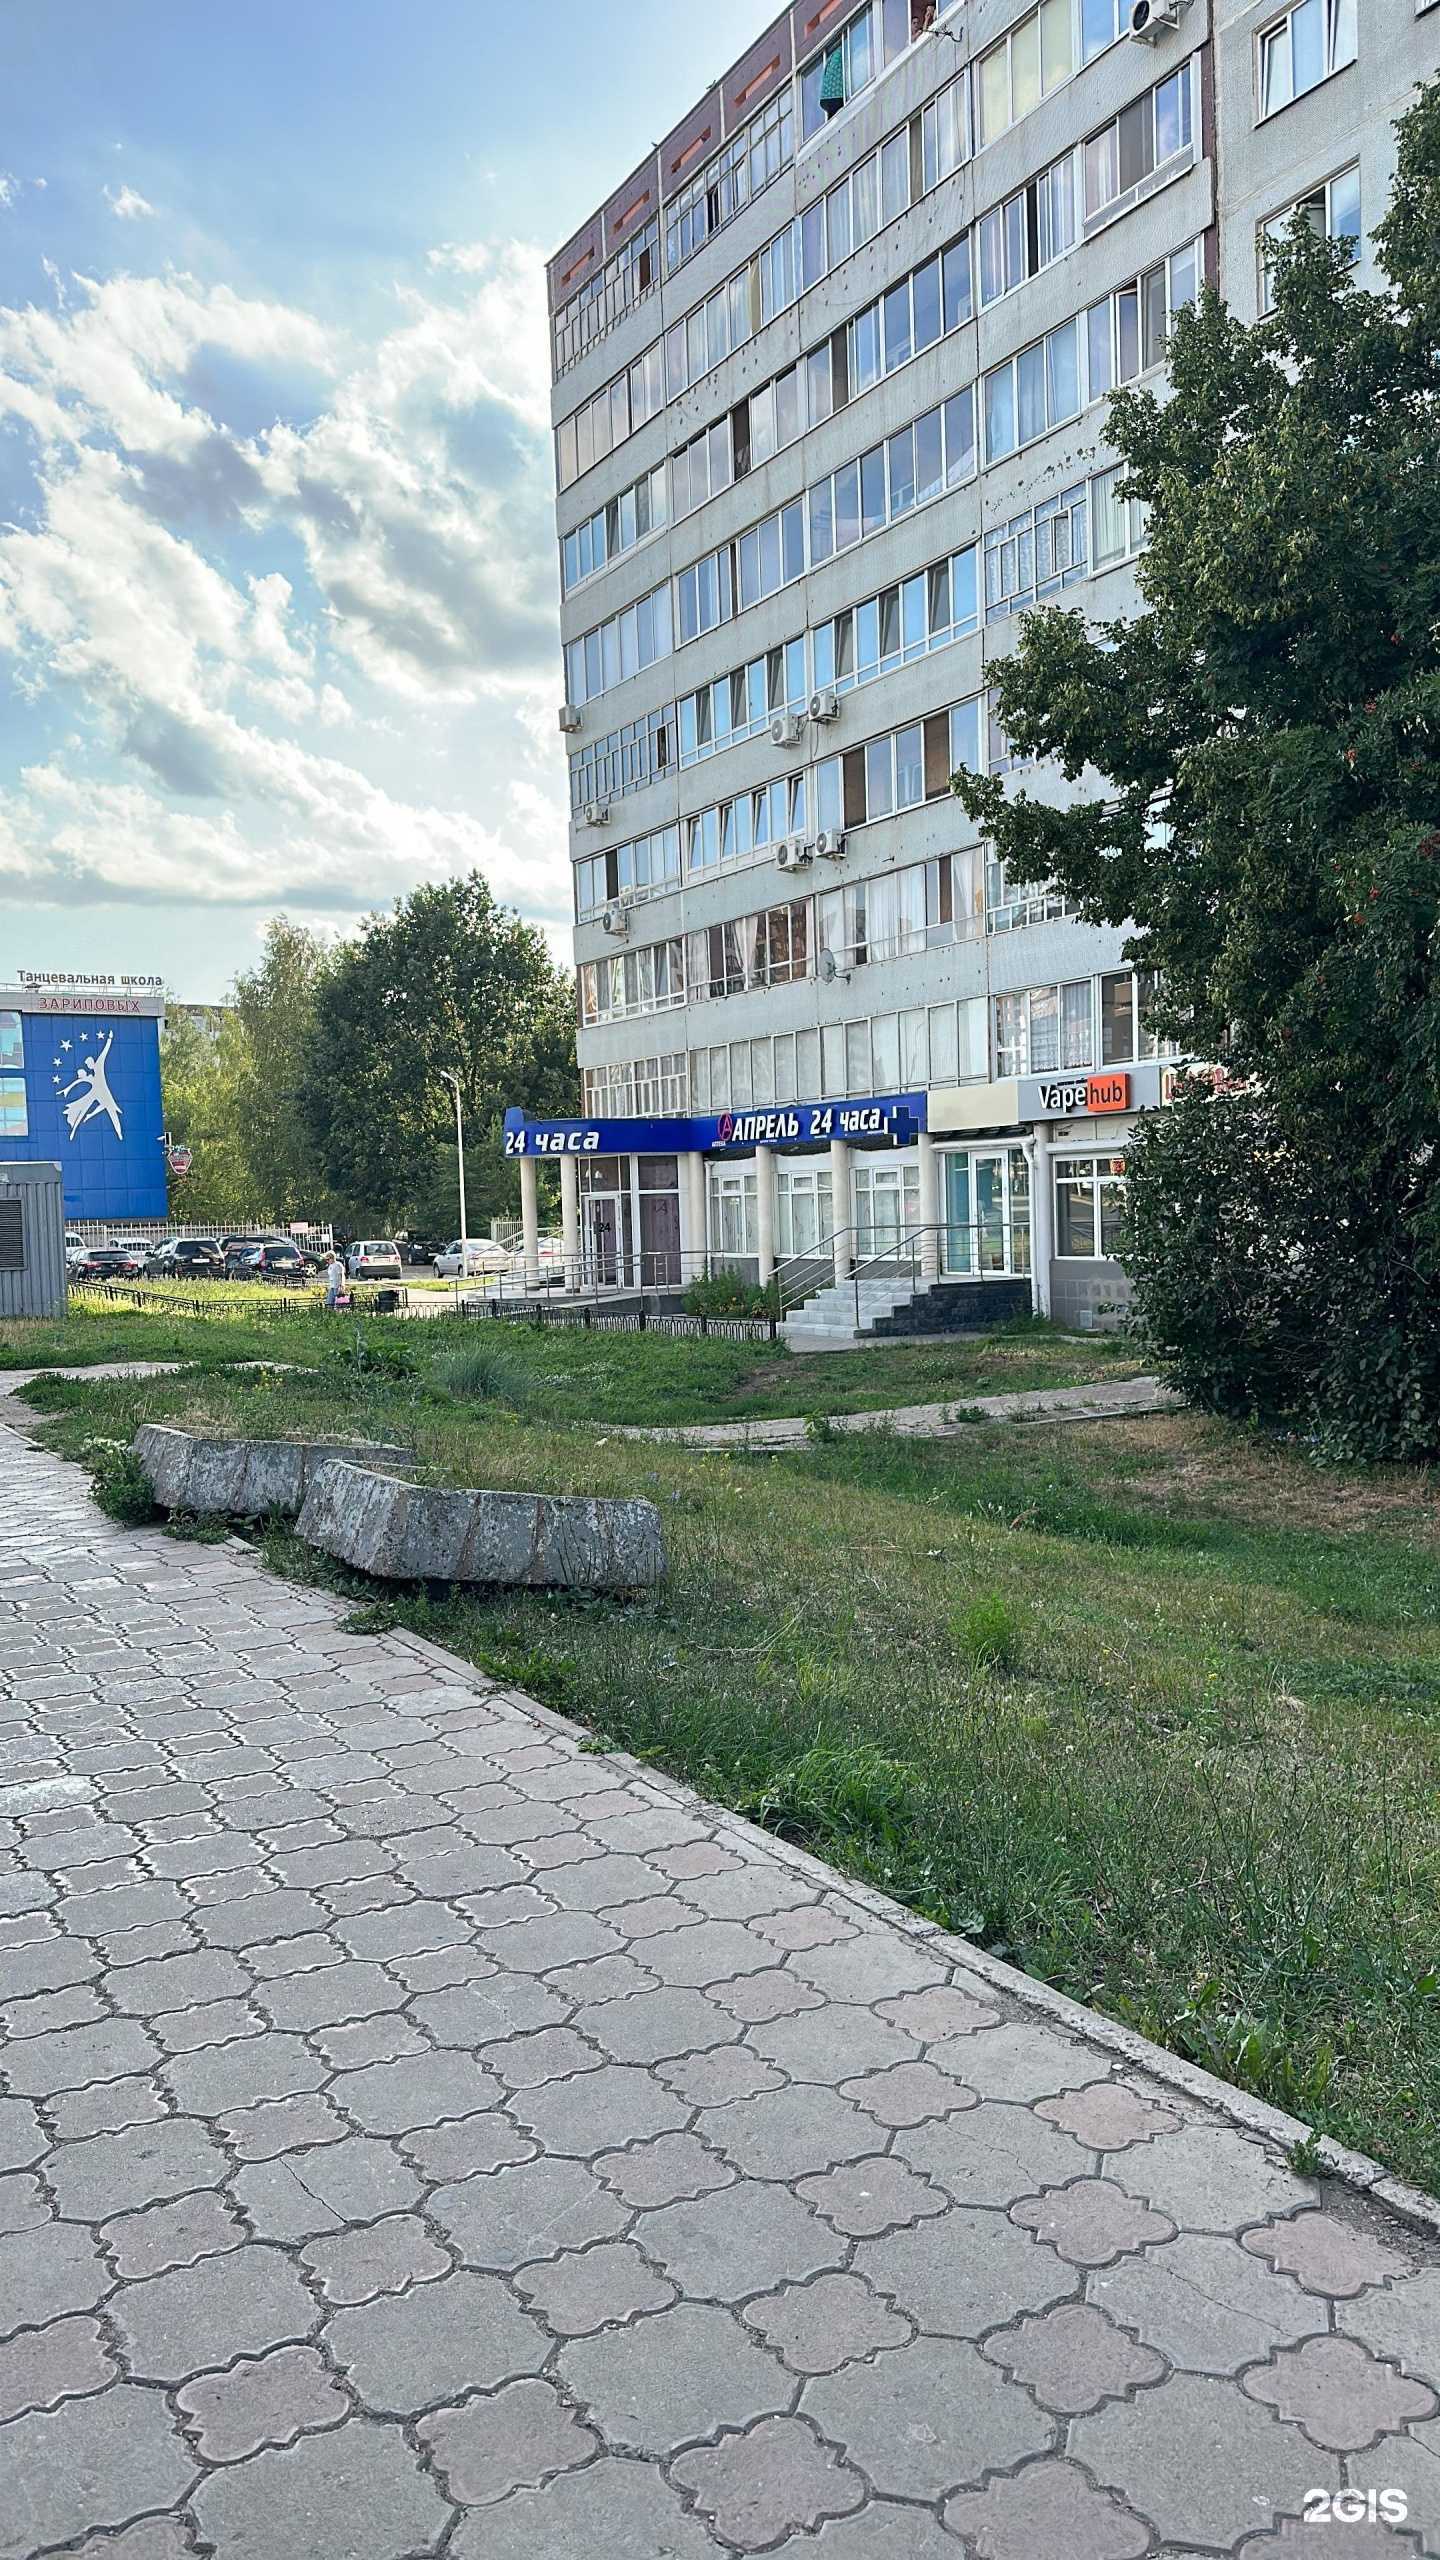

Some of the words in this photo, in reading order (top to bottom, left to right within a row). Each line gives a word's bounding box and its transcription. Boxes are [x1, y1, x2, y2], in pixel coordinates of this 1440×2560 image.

[17, 970, 115, 986] Танцевальная
[122, 975, 162, 986] школа
[39, 997, 141, 1013] ЗАРИПОВЫХ
[732, 1113, 799, 1142] АПРЕЛЬ
[810, 1109, 833, 1135] 24
[839, 1107, 881, 1131] часа
[505, 1130, 526, 1155] 24
[535, 1131, 600, 1152] часа
